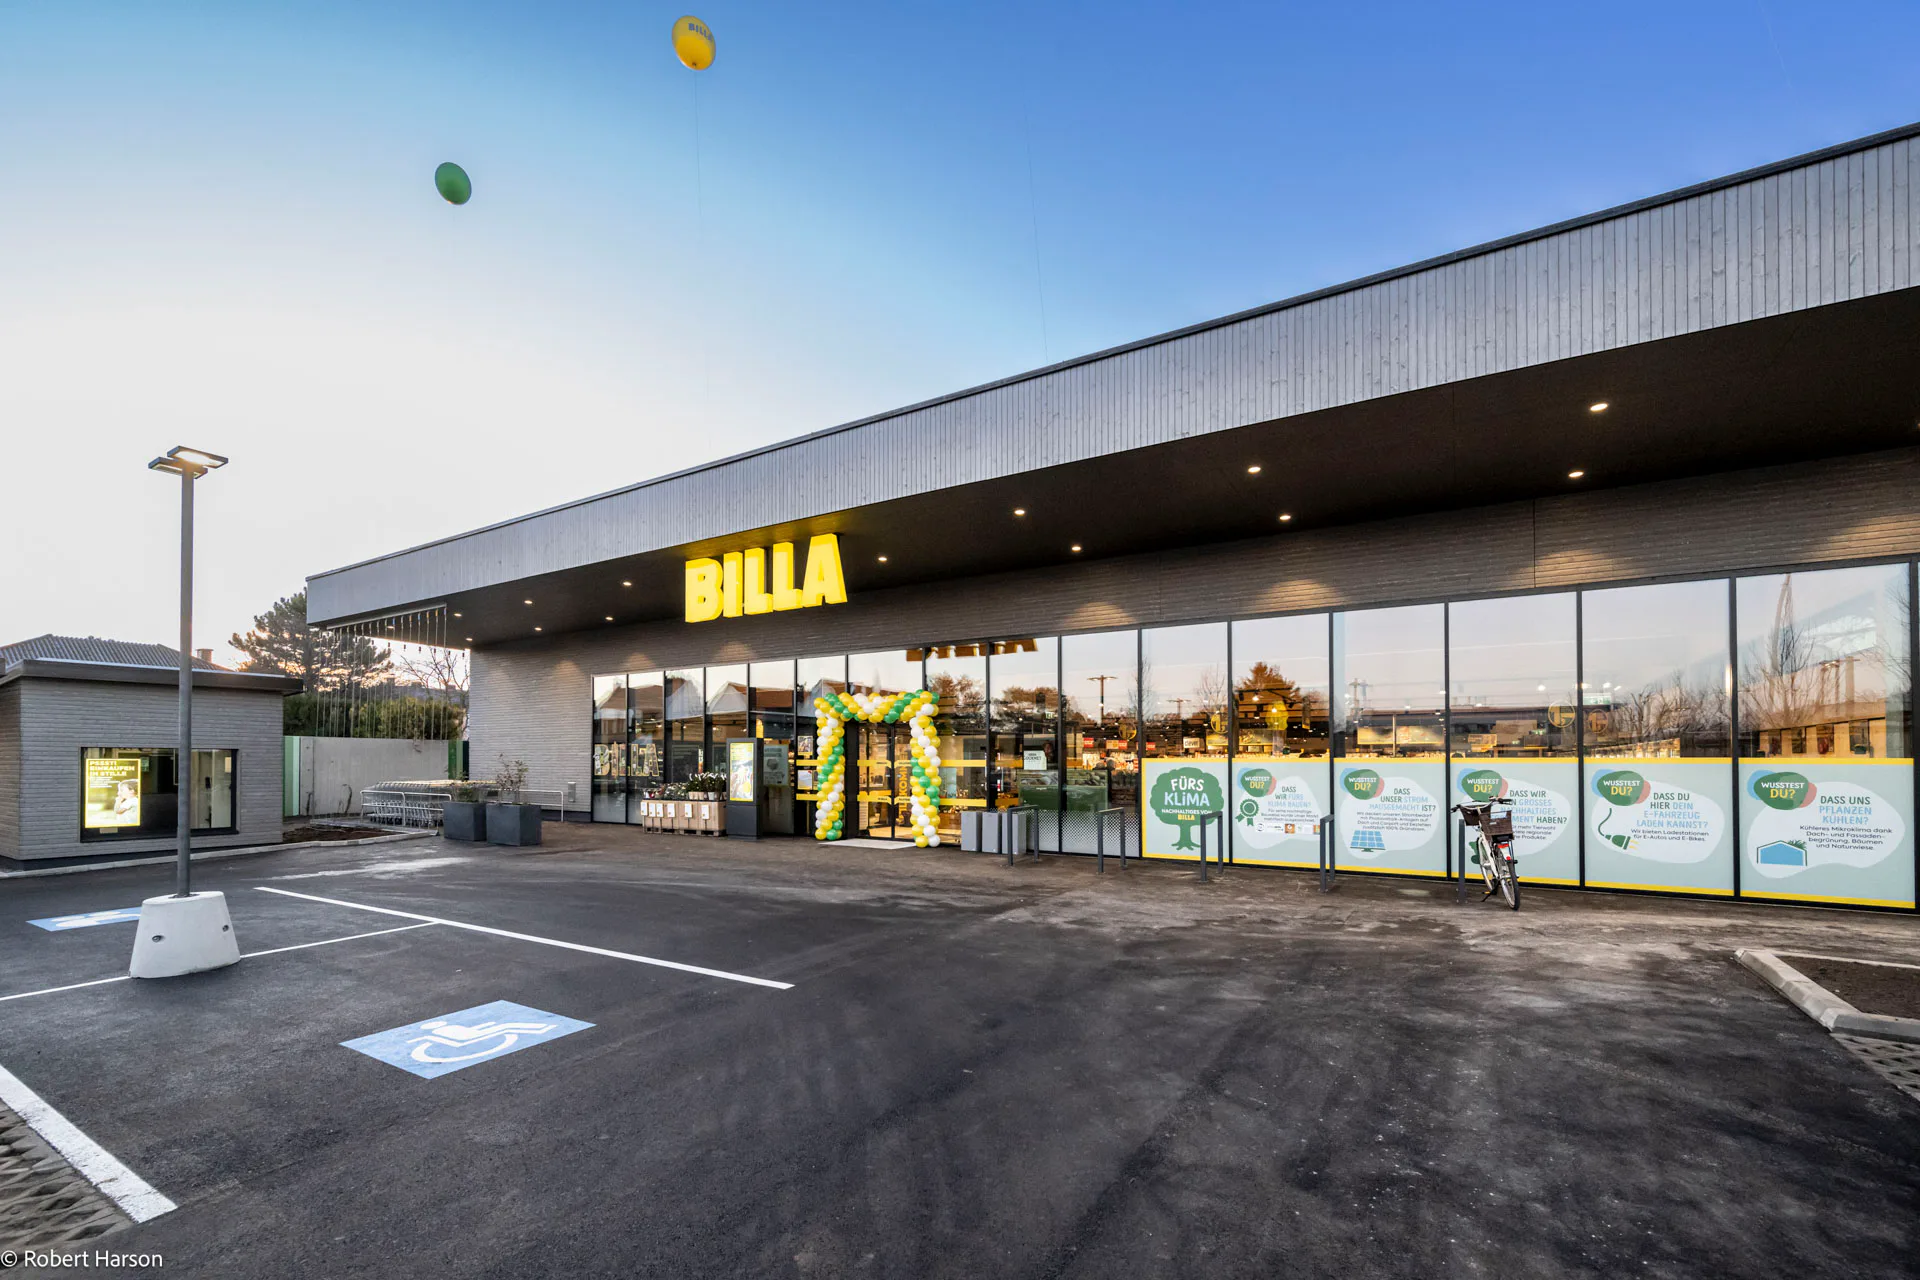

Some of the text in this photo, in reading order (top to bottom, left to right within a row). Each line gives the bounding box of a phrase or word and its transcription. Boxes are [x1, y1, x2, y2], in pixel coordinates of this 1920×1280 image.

[685, 533, 848, 623] BILLA
[594, 743, 659, 776] BILLA
[1170, 776, 1204, 791] FÜRS
[1474, 785, 1492, 793] DU?
[1611, 786, 1632, 796] DU?
[1770, 789, 1796, 799] DU?
[1820, 796, 1871, 805] DASS UNS
[1644, 811, 1700, 819] E-FAHRZEUG
[1819, 806, 1872, 815] PFLANZEN
